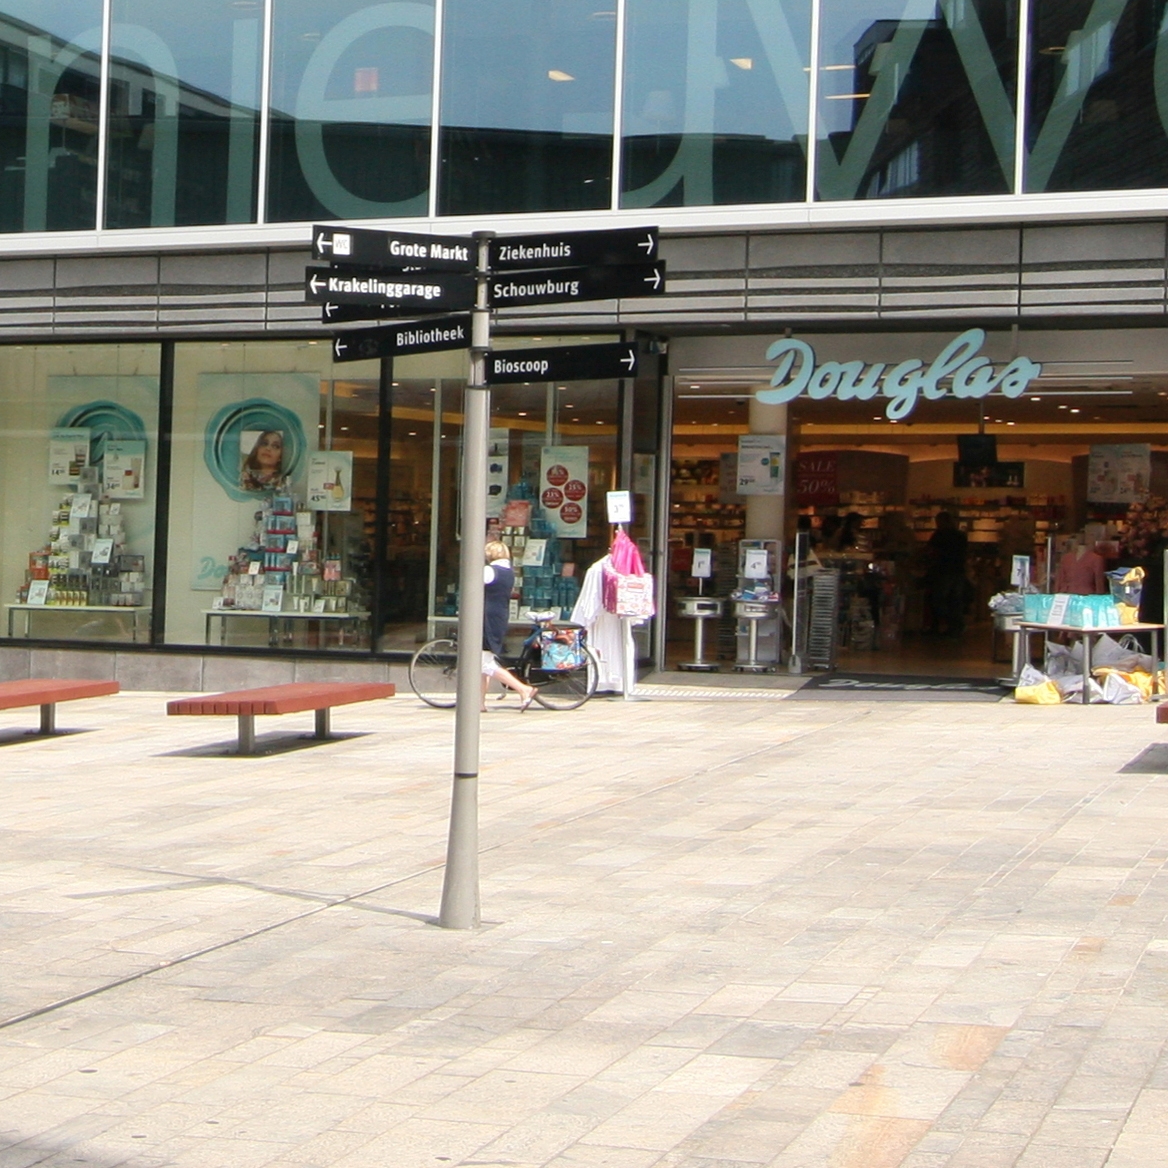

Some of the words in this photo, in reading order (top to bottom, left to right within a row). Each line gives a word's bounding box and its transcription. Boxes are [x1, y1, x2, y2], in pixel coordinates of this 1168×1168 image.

[390, 240, 427, 257] Grote
[430, 243, 468, 261] Markt
[498, 244, 571, 261] Ziekenhuis
[329, 277, 441, 299] Krakelinggarage
[493, 279, 579, 298] Schouwburg
[396, 325, 464, 346] Bibliotheek
[494, 359, 548, 375] Bioscoop
[755, 327, 1042, 420] Douglas
[799, 460, 836, 472] SALE
[798, 479, 835, 493] 50%
